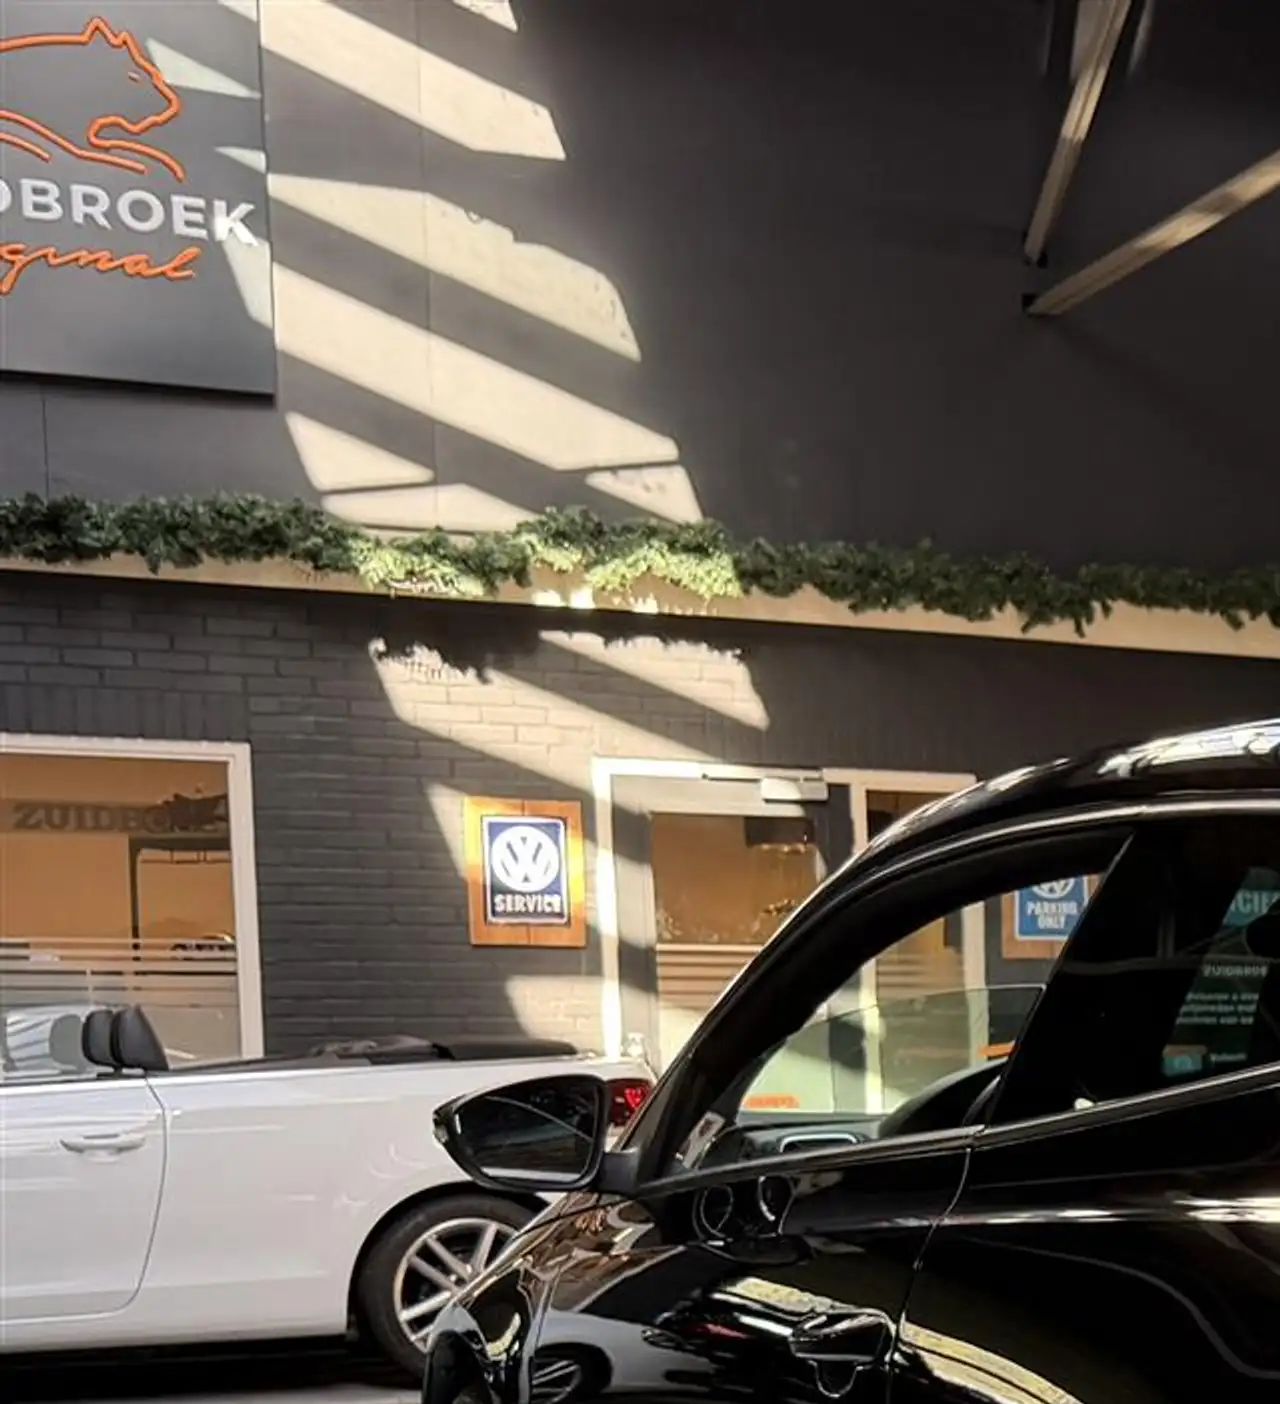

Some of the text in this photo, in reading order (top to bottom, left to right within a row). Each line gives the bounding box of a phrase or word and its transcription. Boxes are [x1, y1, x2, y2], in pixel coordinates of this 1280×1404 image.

[0, 177, 259, 247] BROEK
[494, 893, 562, 915] SERVICE
[1026, 900, 1078, 916] PARKING
[1037, 914, 1066, 930] ONLY
